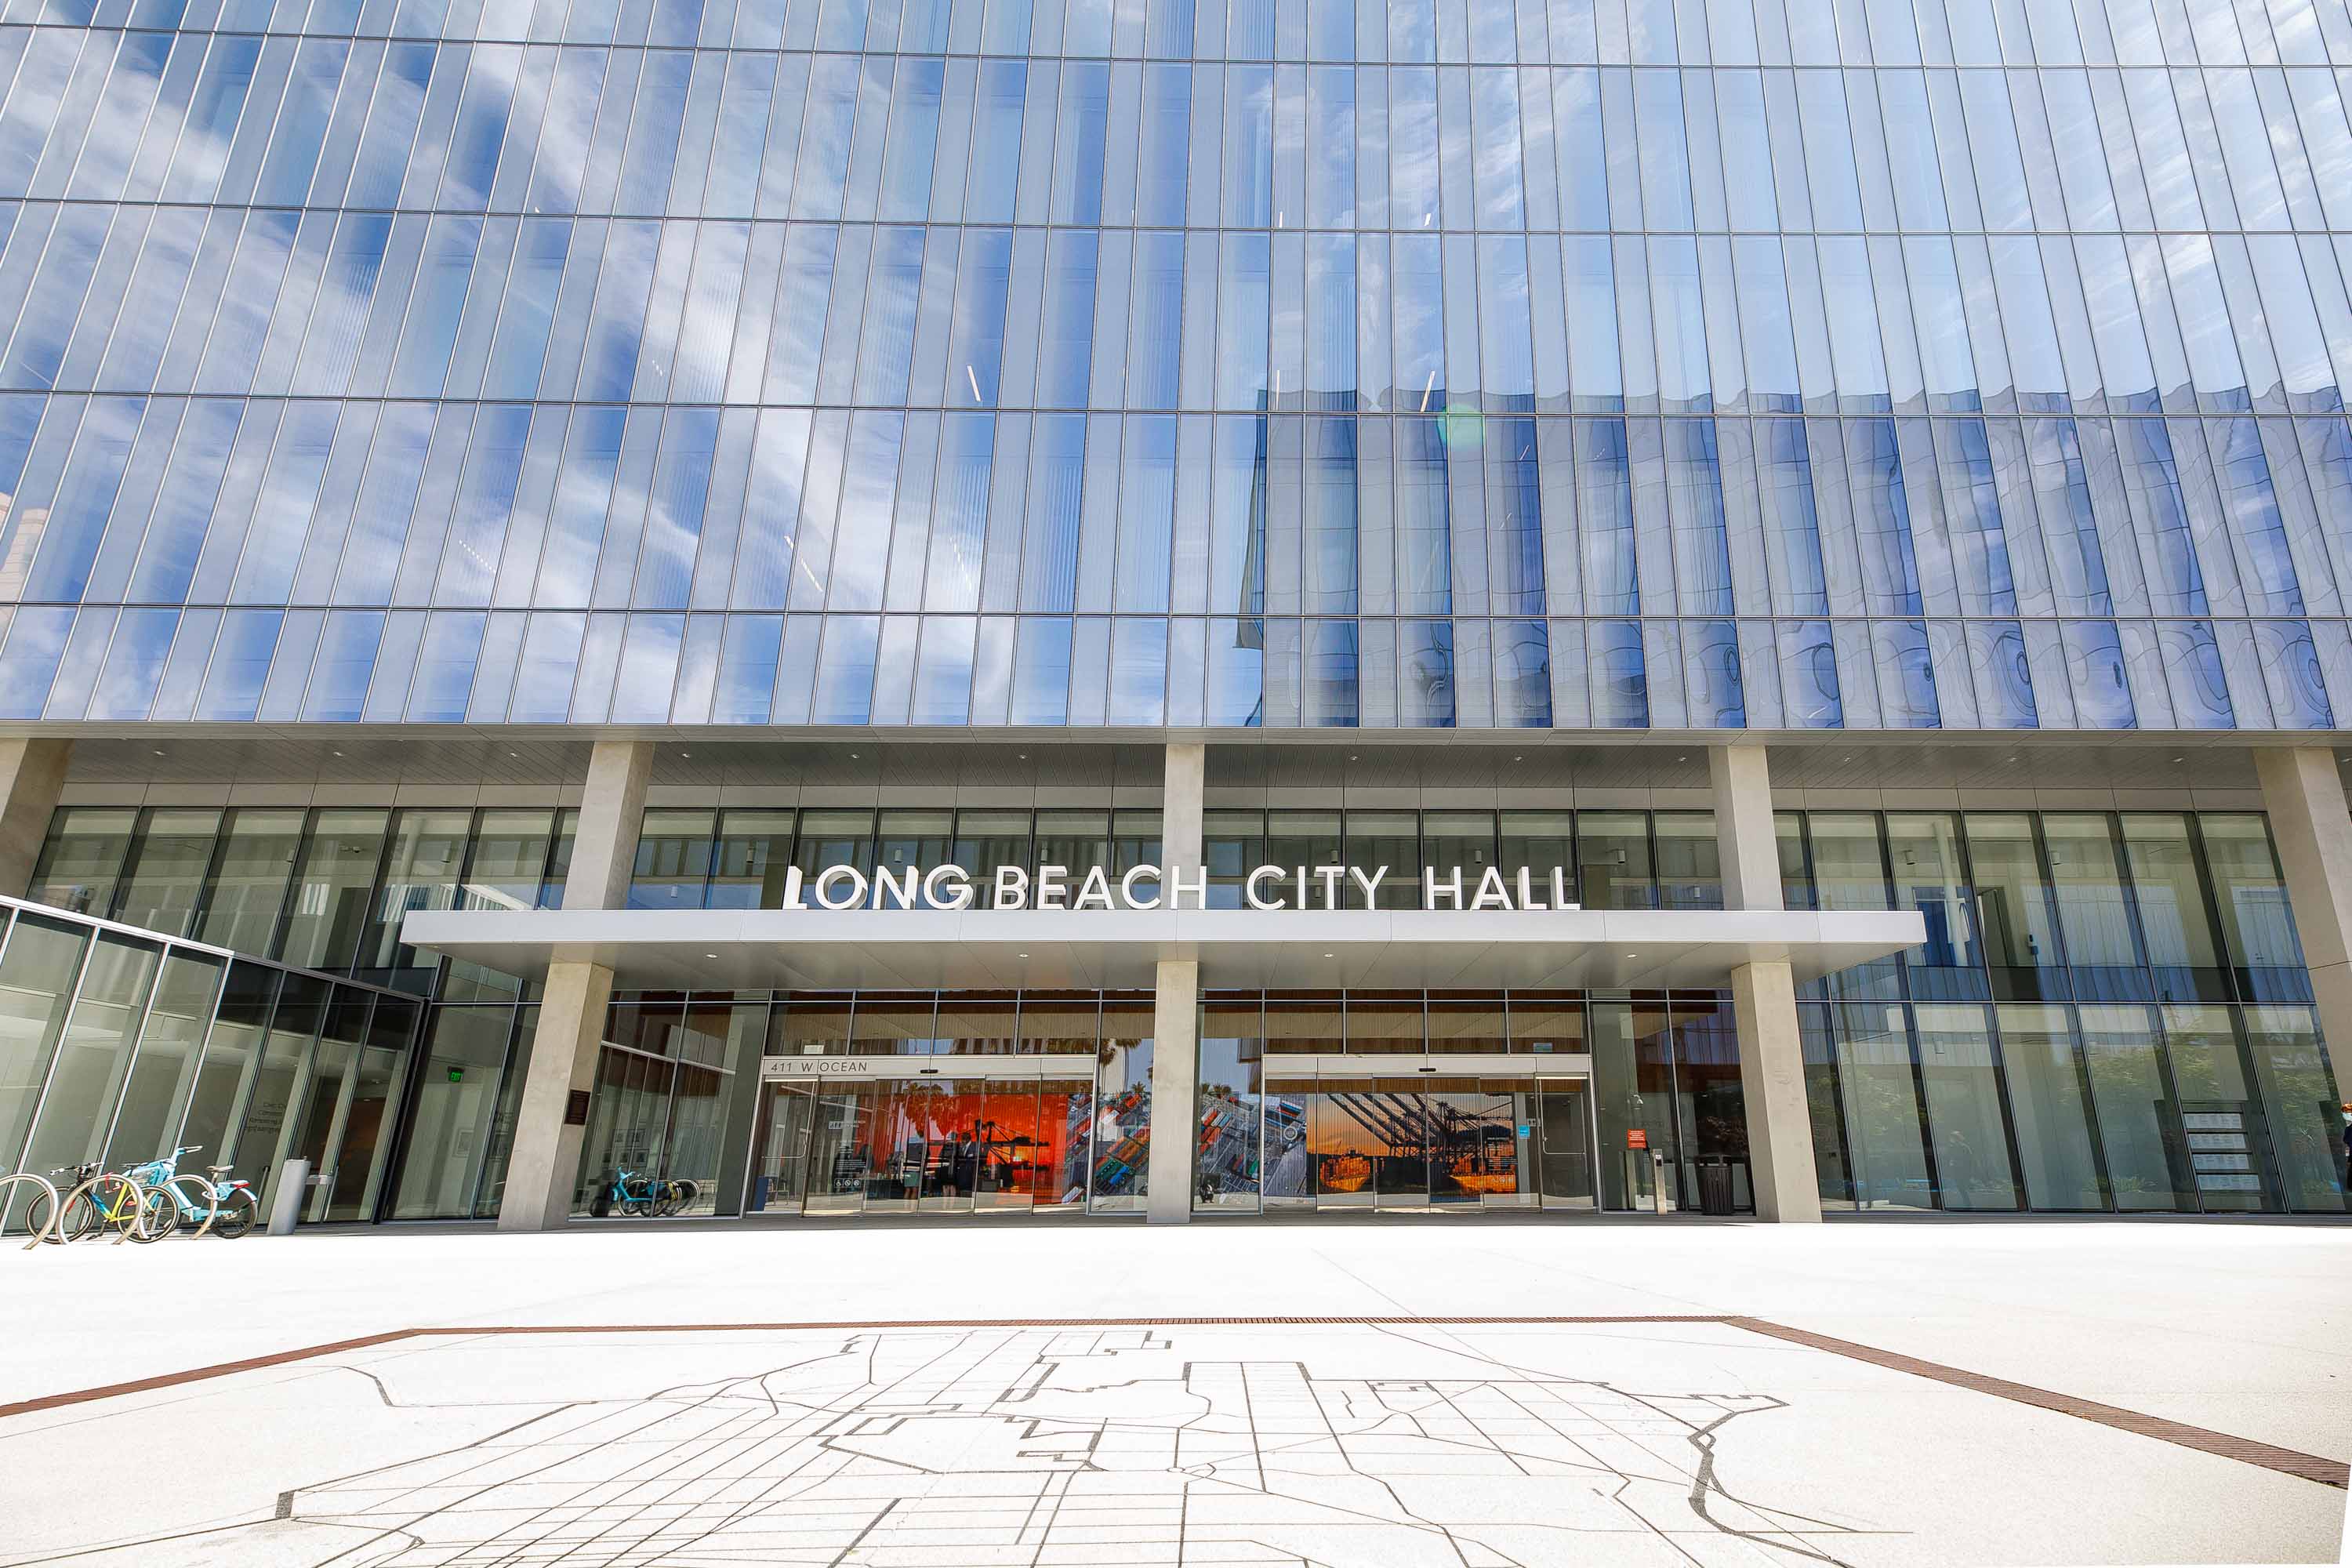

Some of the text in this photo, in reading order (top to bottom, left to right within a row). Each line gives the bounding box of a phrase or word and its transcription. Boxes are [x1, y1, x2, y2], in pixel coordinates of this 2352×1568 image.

[783, 864, 1581, 910] LONG BEACH CITY HALL
[771, 1062, 867, 1073] 411 W OCEAN
[451, 1072, 460, 1080] EXIT
